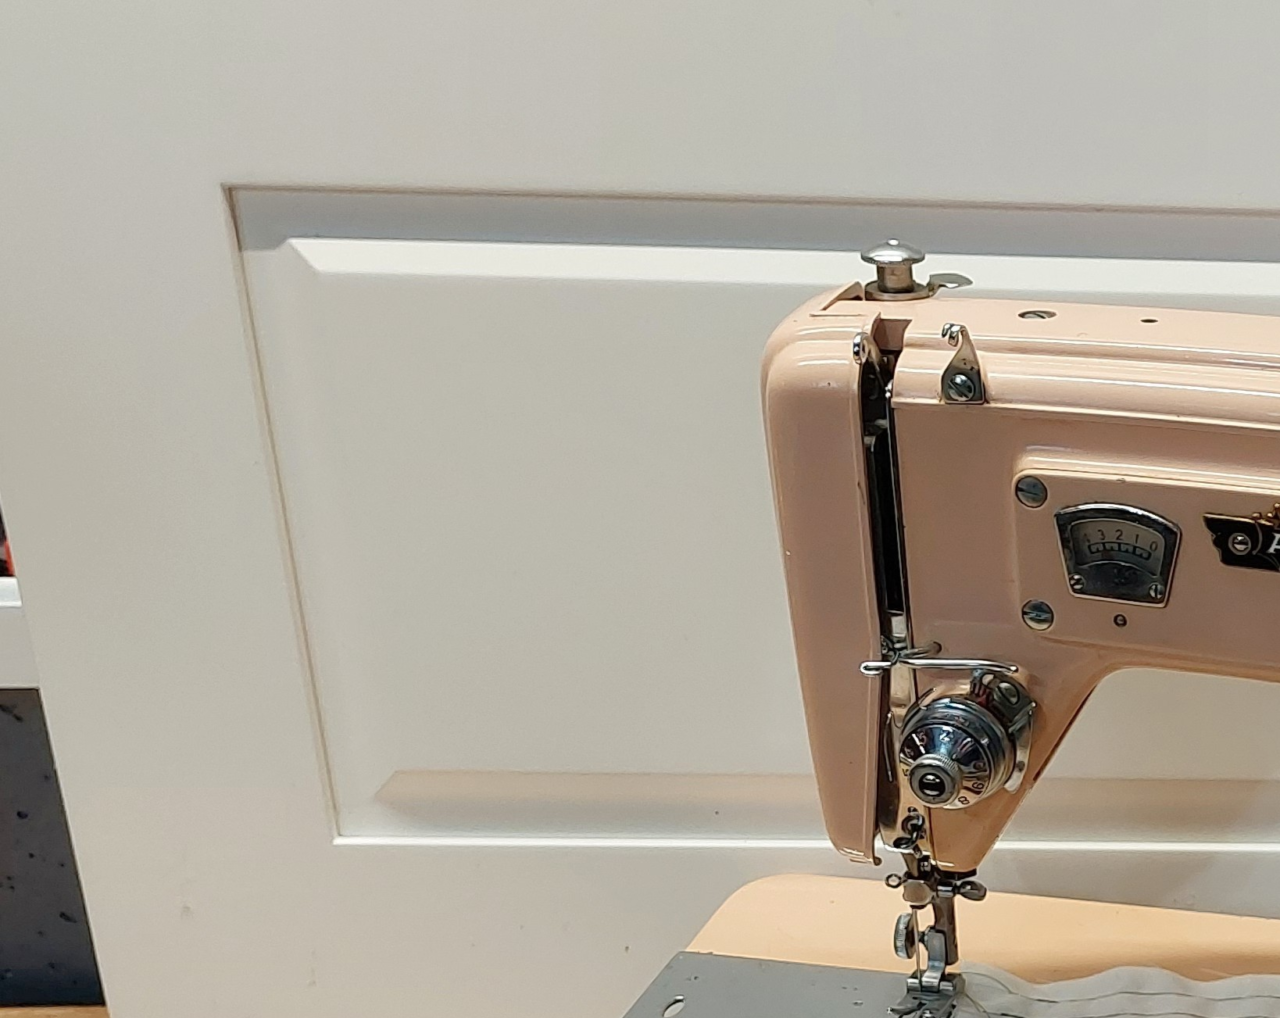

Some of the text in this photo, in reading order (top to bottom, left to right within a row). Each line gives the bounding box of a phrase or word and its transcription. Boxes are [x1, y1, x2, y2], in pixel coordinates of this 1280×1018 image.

[1098, 529, 1105, 540] 3
[1115, 529, 1123, 540] 2
[1150, 541, 1158, 552] 0
